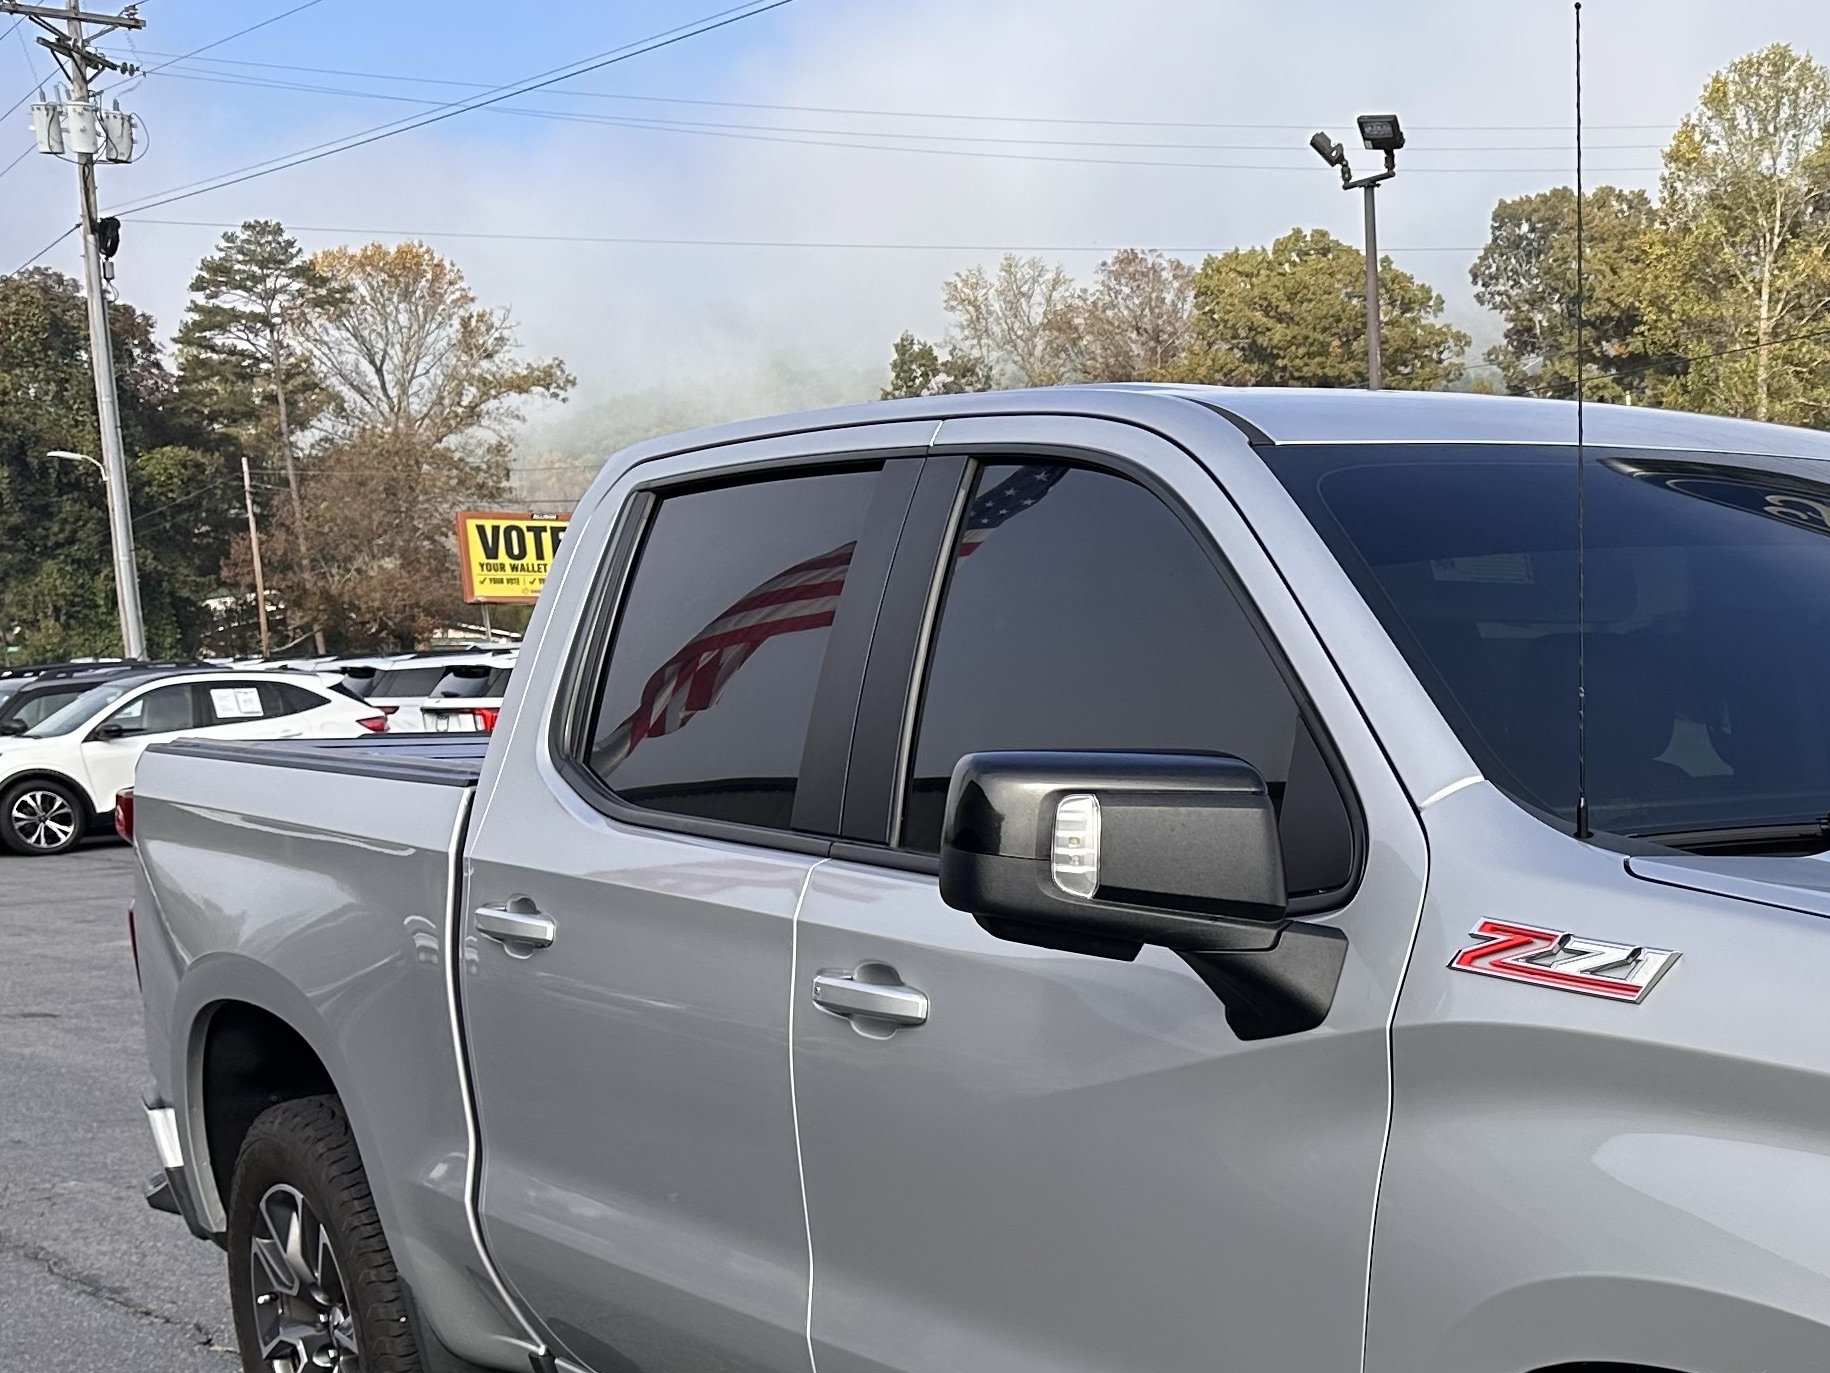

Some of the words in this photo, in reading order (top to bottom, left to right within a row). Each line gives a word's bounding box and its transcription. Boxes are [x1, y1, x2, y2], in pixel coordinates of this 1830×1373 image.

[479, 562, 506, 573] YOUR
[509, 563, 548, 573] WALLET
[1446, 916, 1684, 1005] Z71
